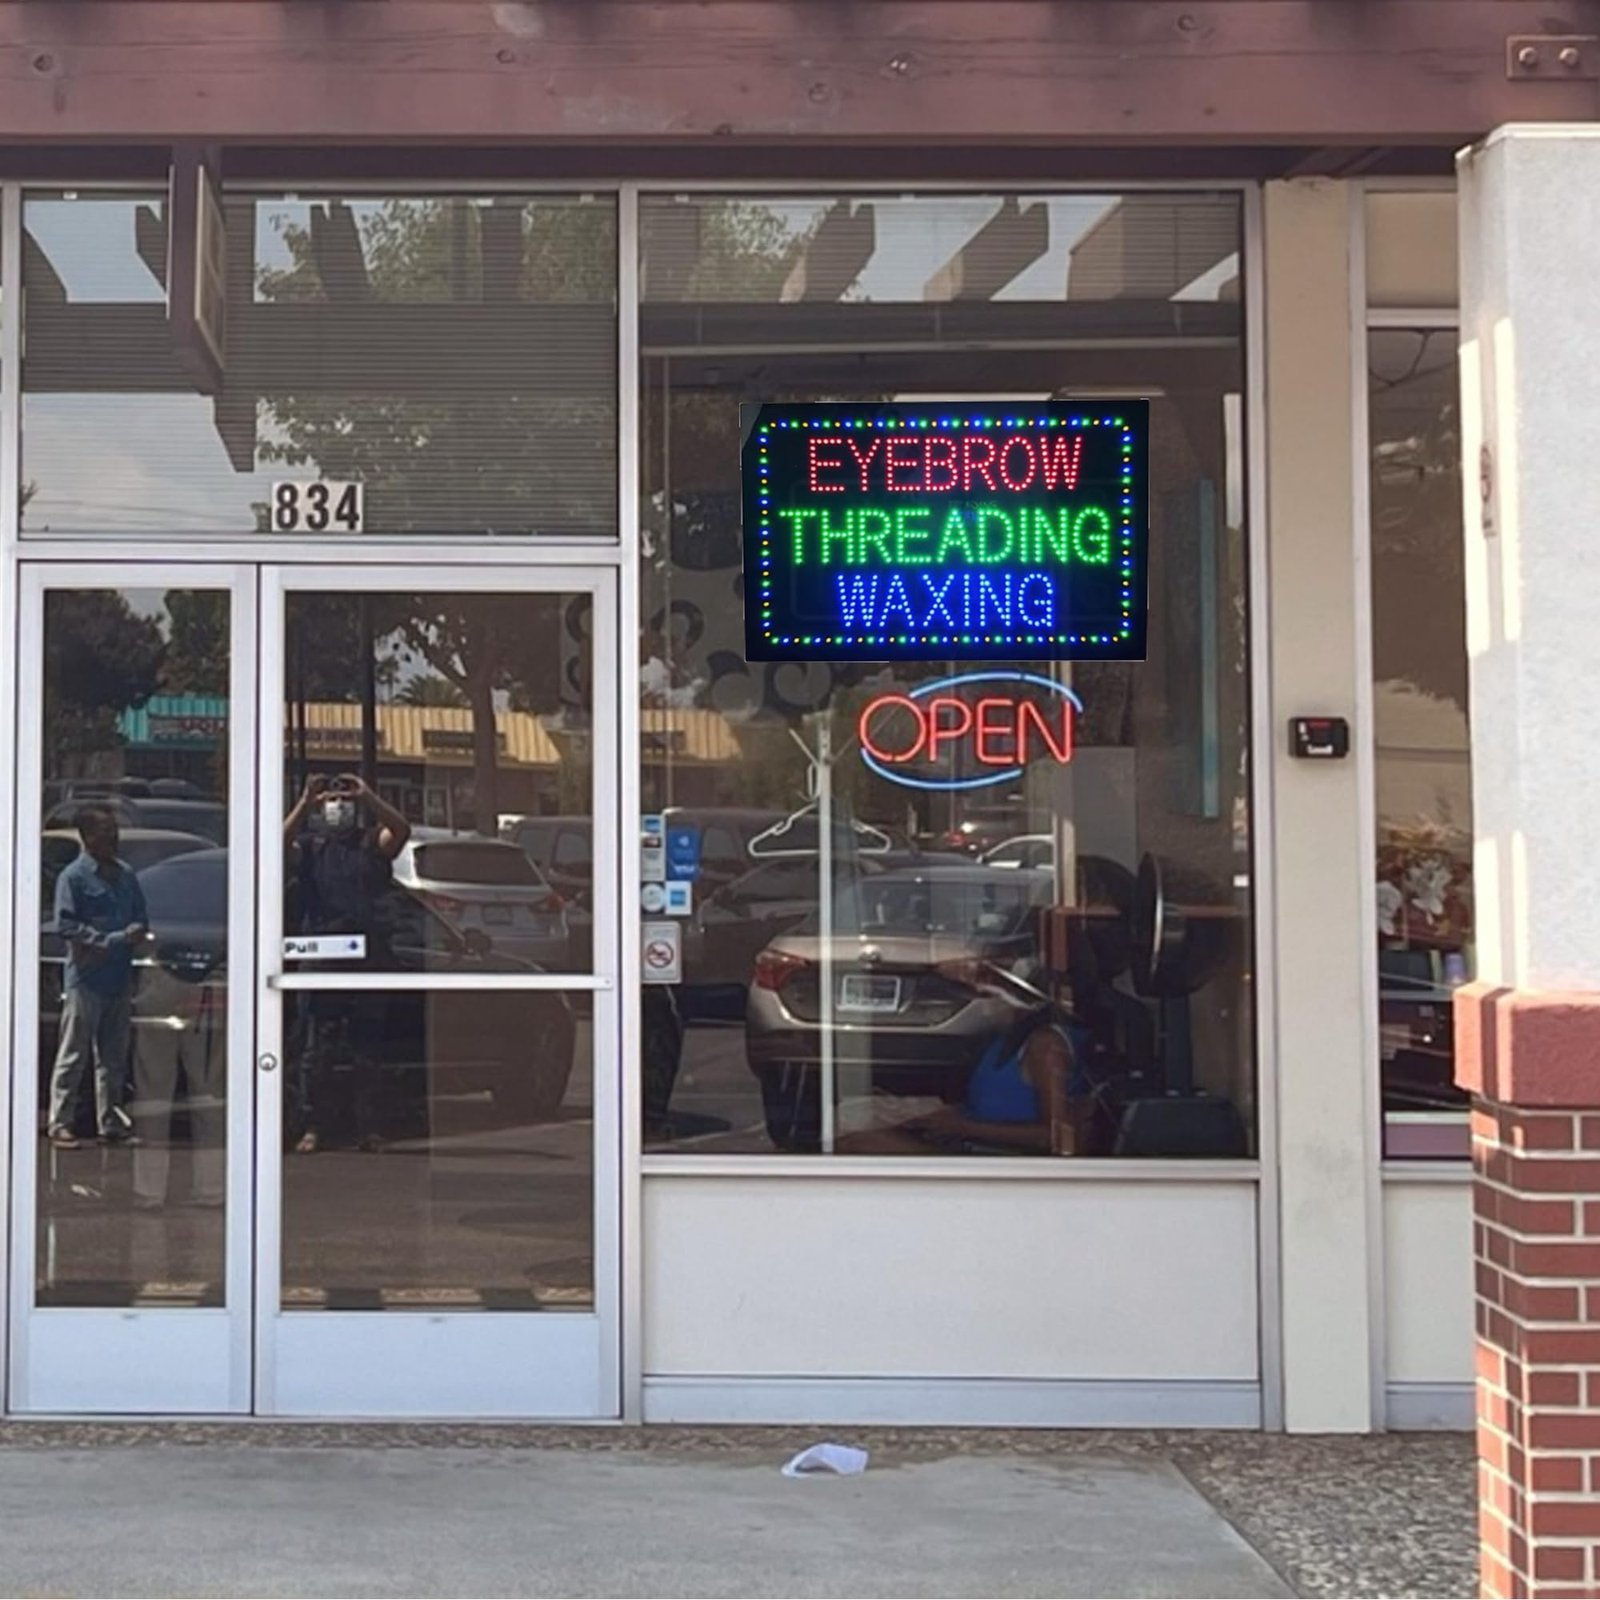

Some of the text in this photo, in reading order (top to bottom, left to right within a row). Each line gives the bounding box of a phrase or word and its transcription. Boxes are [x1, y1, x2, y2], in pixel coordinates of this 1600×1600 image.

[808, 436, 1083, 492] EYEBROW
[276, 484, 360, 530] 834
[778, 507, 1112, 564] THREADING
[836, 573, 1055, 628] WAXING
[859, 695, 1073, 765] OPEN
